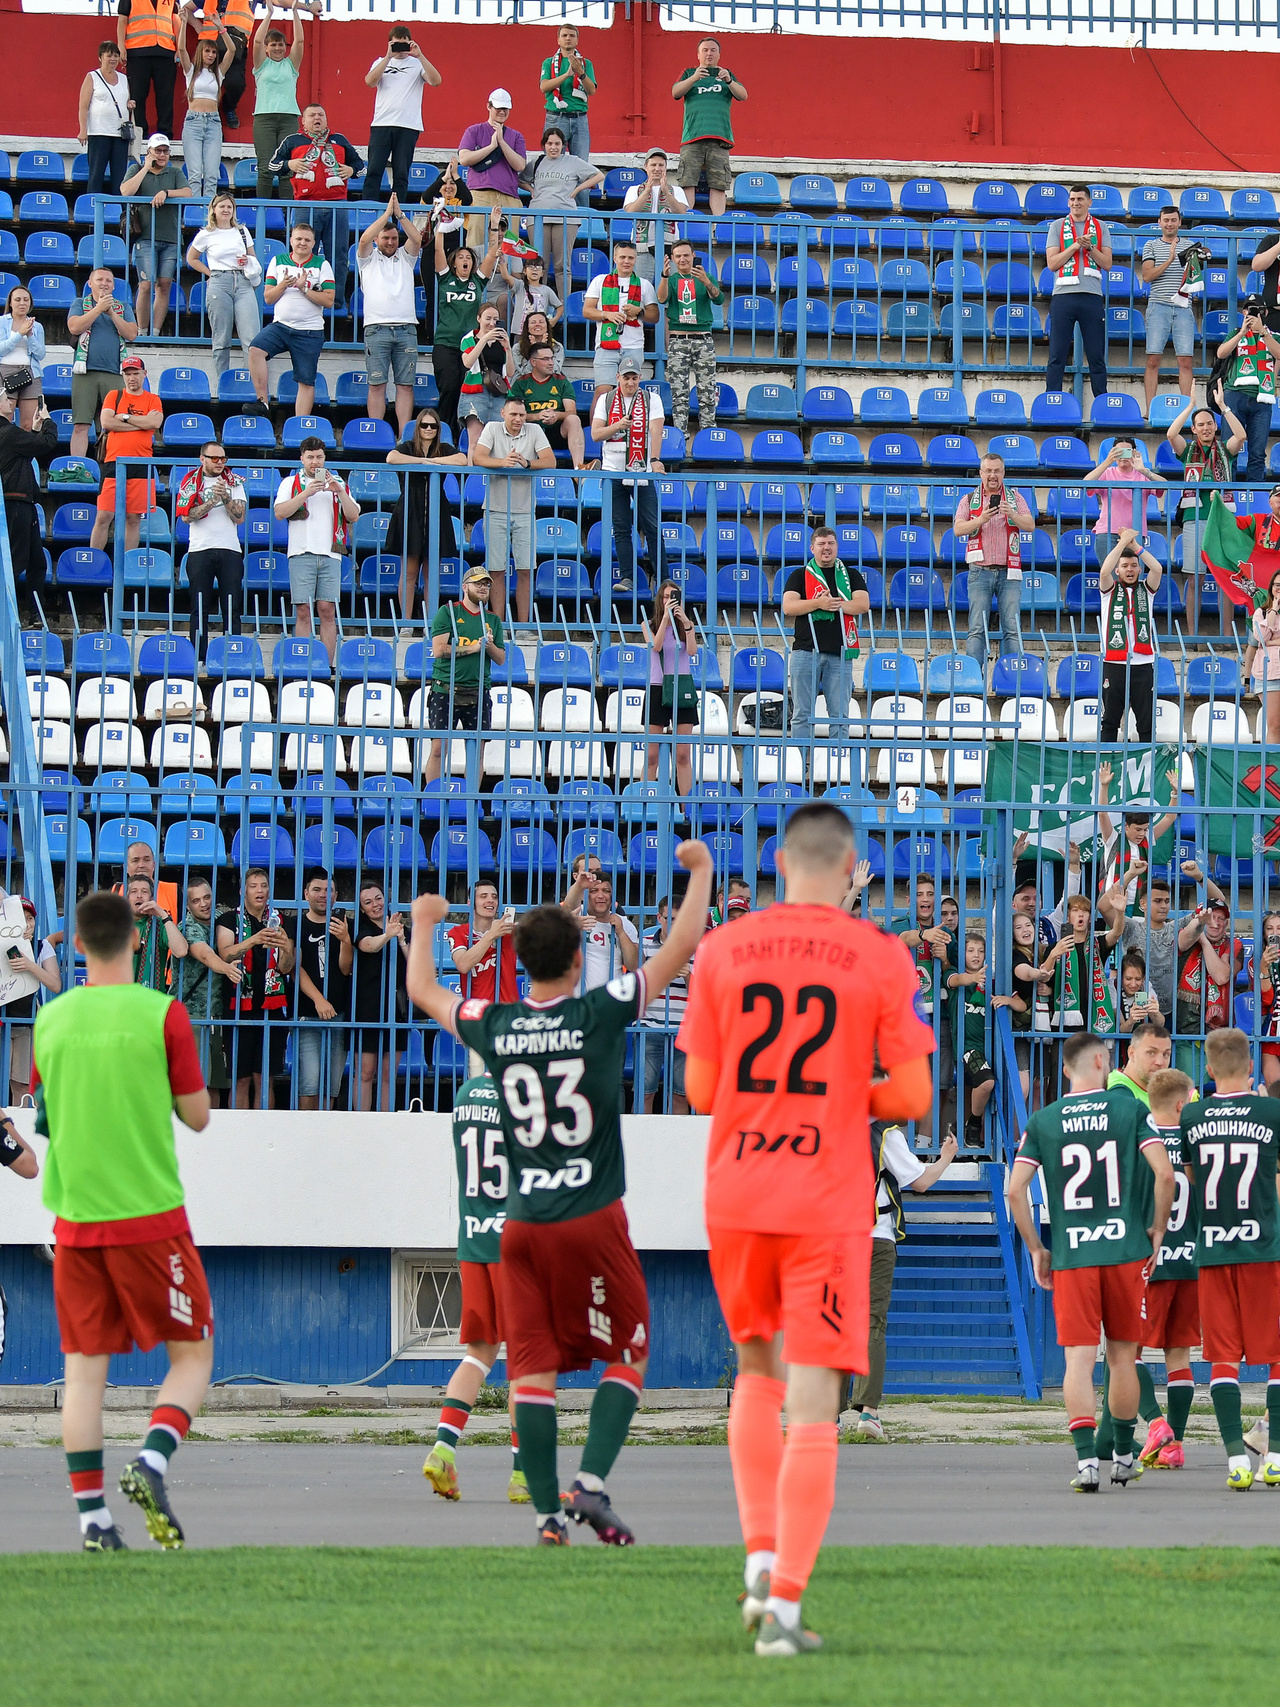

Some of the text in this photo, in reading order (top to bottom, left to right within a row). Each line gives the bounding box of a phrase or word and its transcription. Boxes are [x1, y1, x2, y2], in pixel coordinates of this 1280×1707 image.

[104, 685, 110, 693] 2
[171, 685, 178, 694] 3
[237, 688, 244, 696] 4
[370, 691, 377, 699] 6
[628, 697, 640, 705] 10
[111, 731, 118, 740] 2
[177, 734, 184, 742] 3
[900, 753, 912, 762] 14
[901, 791, 910, 806] 4
[192, 829, 199, 838] 3
[731, 936, 858, 971] ПАНТРАТОВ
[737, 982, 837, 1096] 22
[503, 1057, 593, 1148] 93
[453, 1104, 500, 1124] ГЛУШЕН
[1061, 1114, 1109, 1134] МИТАЙ
[1187, 1121, 1273, 1145] САМОШНИКОВ
[460, 1126, 509, 1199] 15
[1061, 1140, 1120, 1211] 21
[1199, 1142, 1259, 1210] 77
